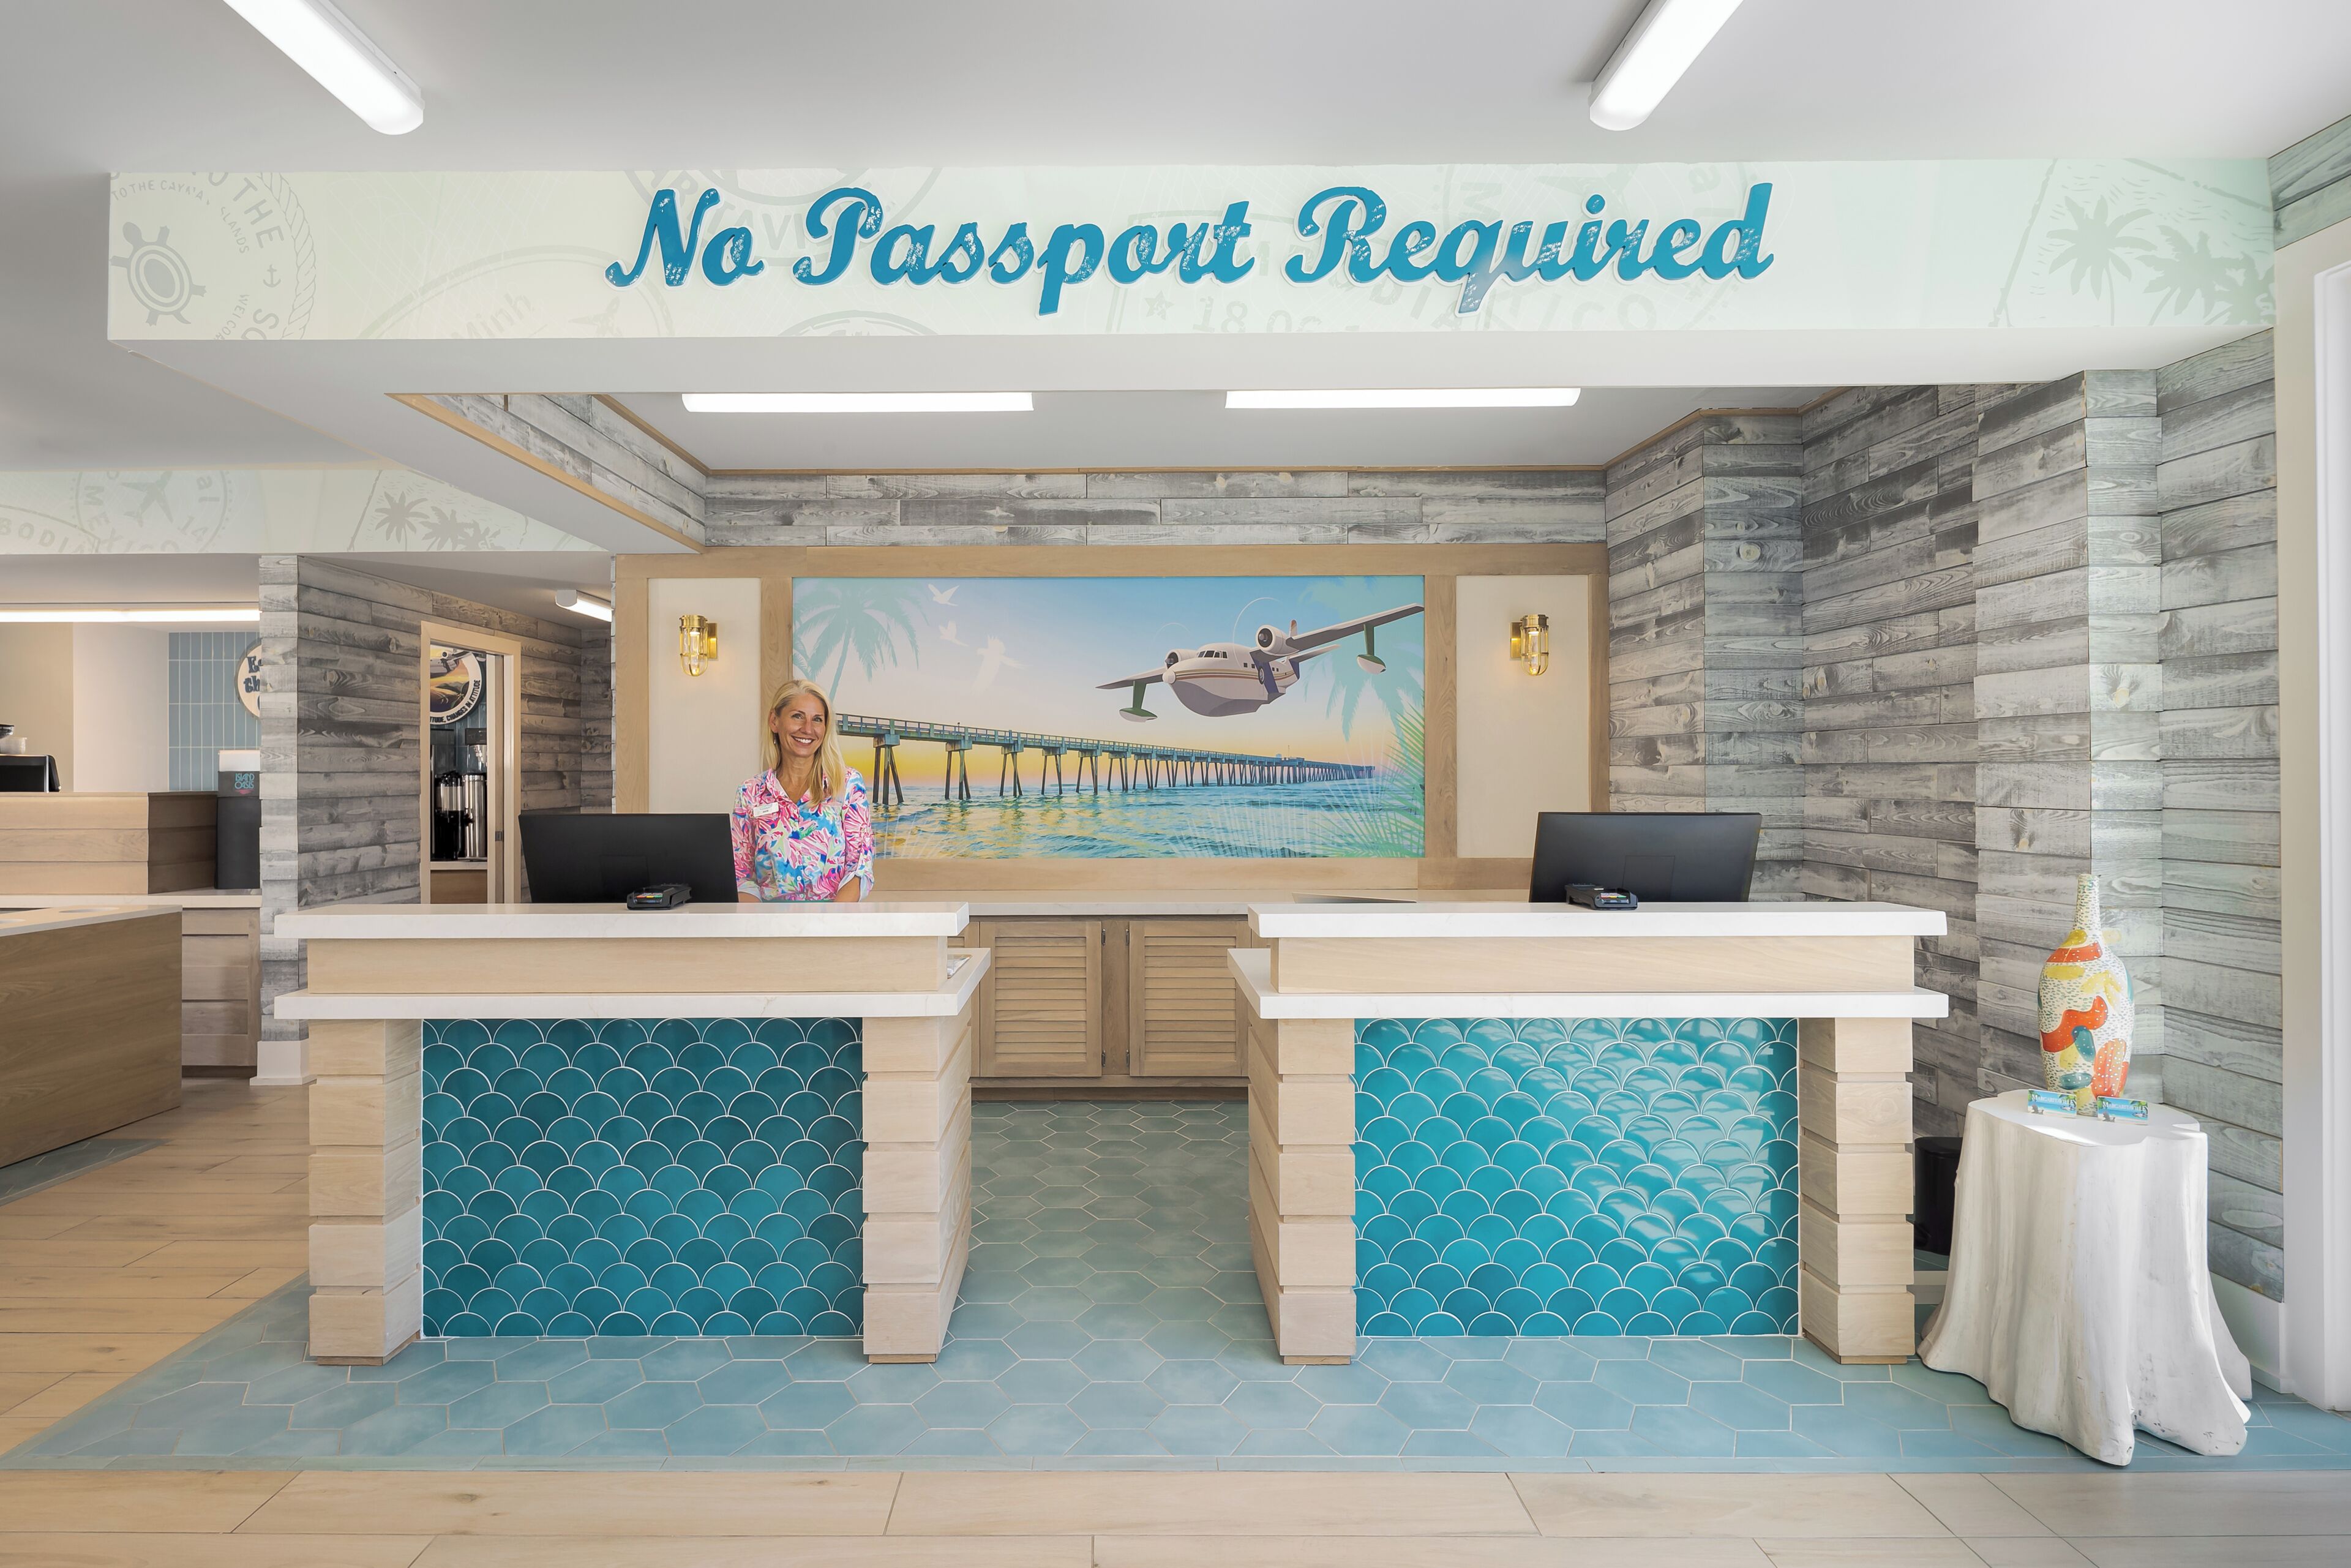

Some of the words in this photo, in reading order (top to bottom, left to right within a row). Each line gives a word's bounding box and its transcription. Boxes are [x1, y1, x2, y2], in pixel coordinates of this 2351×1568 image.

[111, 189, 128, 201] TO
[129, 180, 156, 194] THE
[233, 177, 284, 249] THE
[605, 187, 764, 287] No
[793, 186, 1253, 317] Passport
[1284, 182, 1775, 315] Required
[469, 680, 481, 703] ATTITUDE
[235, 773, 255, 781] ISLAND
